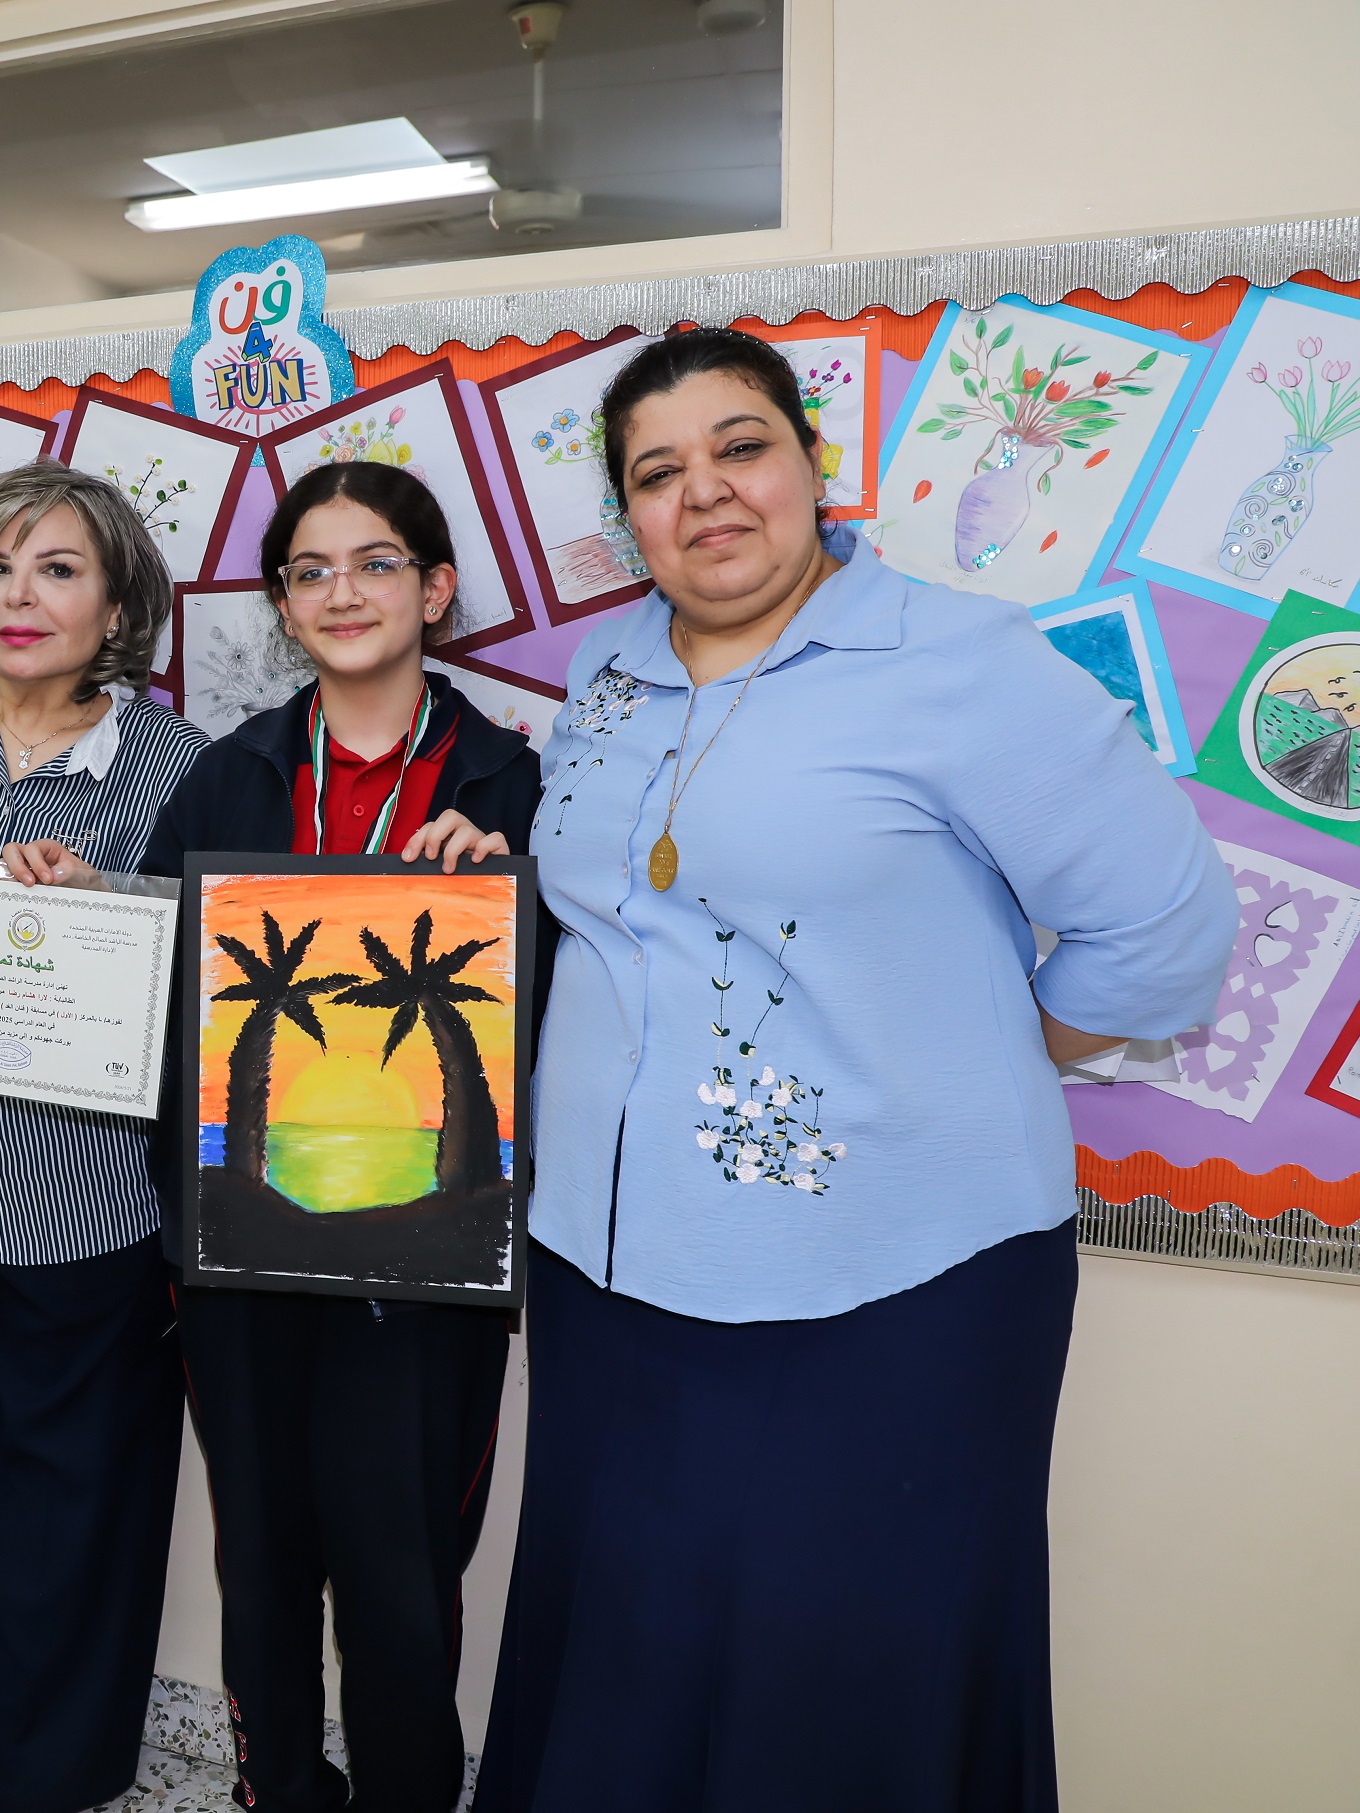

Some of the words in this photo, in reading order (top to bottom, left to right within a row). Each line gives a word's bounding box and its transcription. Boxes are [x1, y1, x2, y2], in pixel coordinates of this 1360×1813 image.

[218, 265, 292, 335] فن
[241, 321, 274, 363] 4
[213, 358, 307, 411] FUN
[16, 955, 55, 974] شهادة
